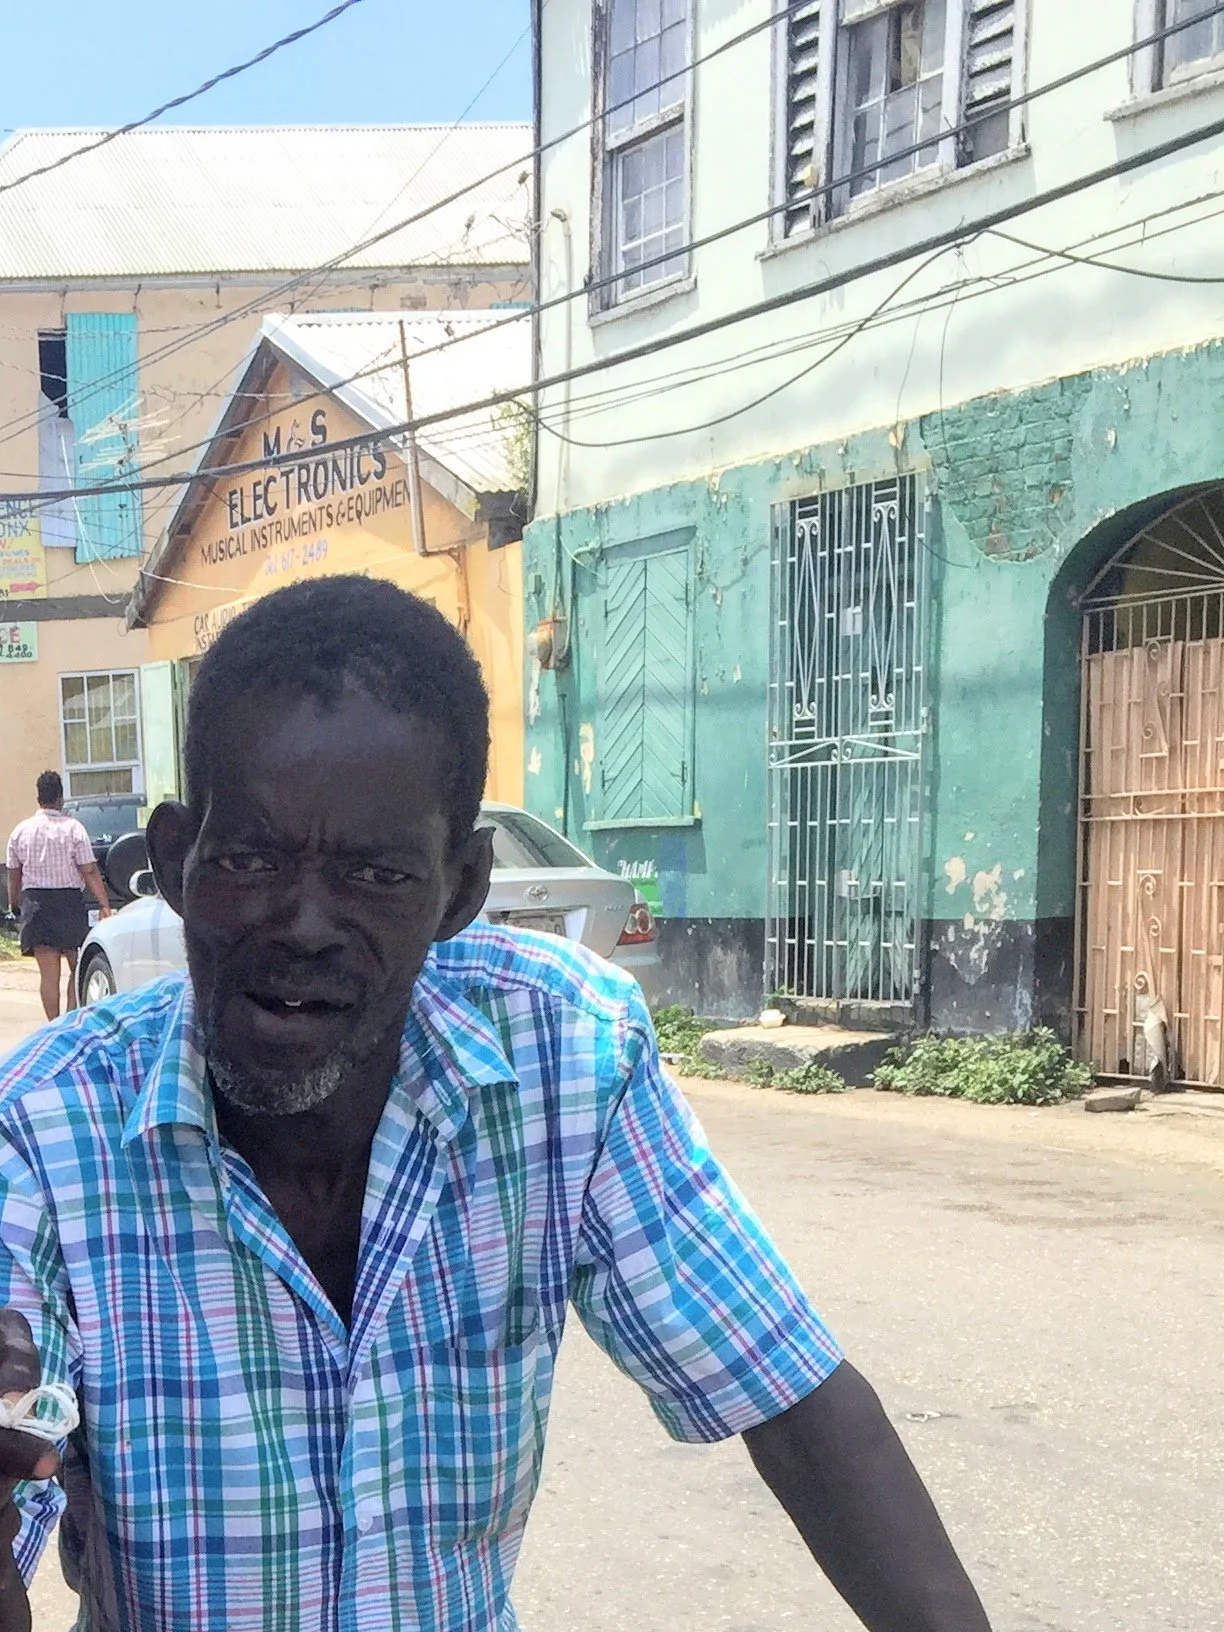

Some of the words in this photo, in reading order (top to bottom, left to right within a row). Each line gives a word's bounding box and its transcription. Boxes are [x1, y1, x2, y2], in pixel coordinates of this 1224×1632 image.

[200, 533, 248, 566] MUSICAL
[250, 503, 334, 553] INSTRUMENTS
[347, 478, 412, 526] EQUIPMEN
[228, 443, 387, 530] ELECTRONICS
